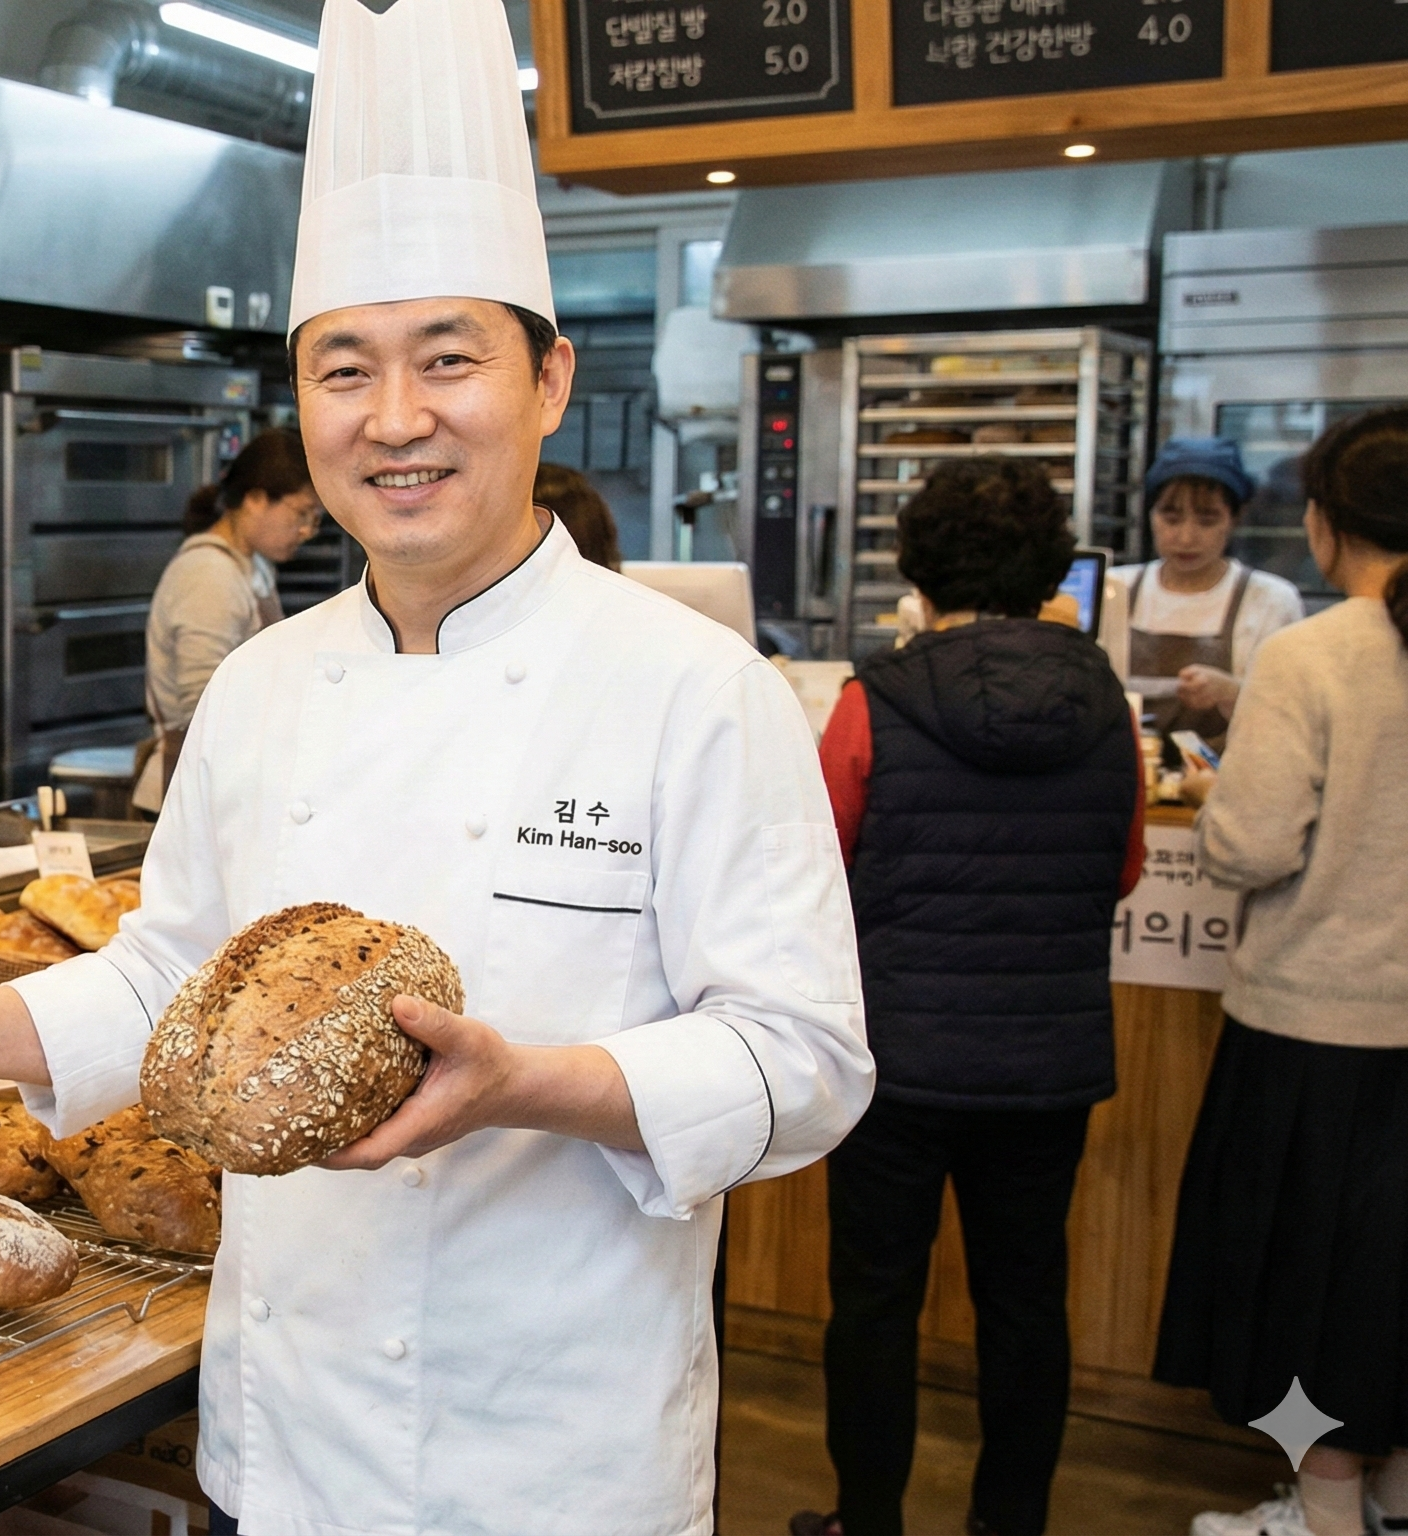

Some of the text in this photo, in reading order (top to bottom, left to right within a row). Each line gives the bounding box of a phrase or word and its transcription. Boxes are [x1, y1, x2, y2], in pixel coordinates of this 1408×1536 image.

[762, 0, 808, 27] 2.0
[1137, 13, 1192, 45] 4.0
[764, 44, 809, 76] 5.0
[554, 798, 610, 826] 김 수
[517, 826, 643, 855] Kim Han-soo
